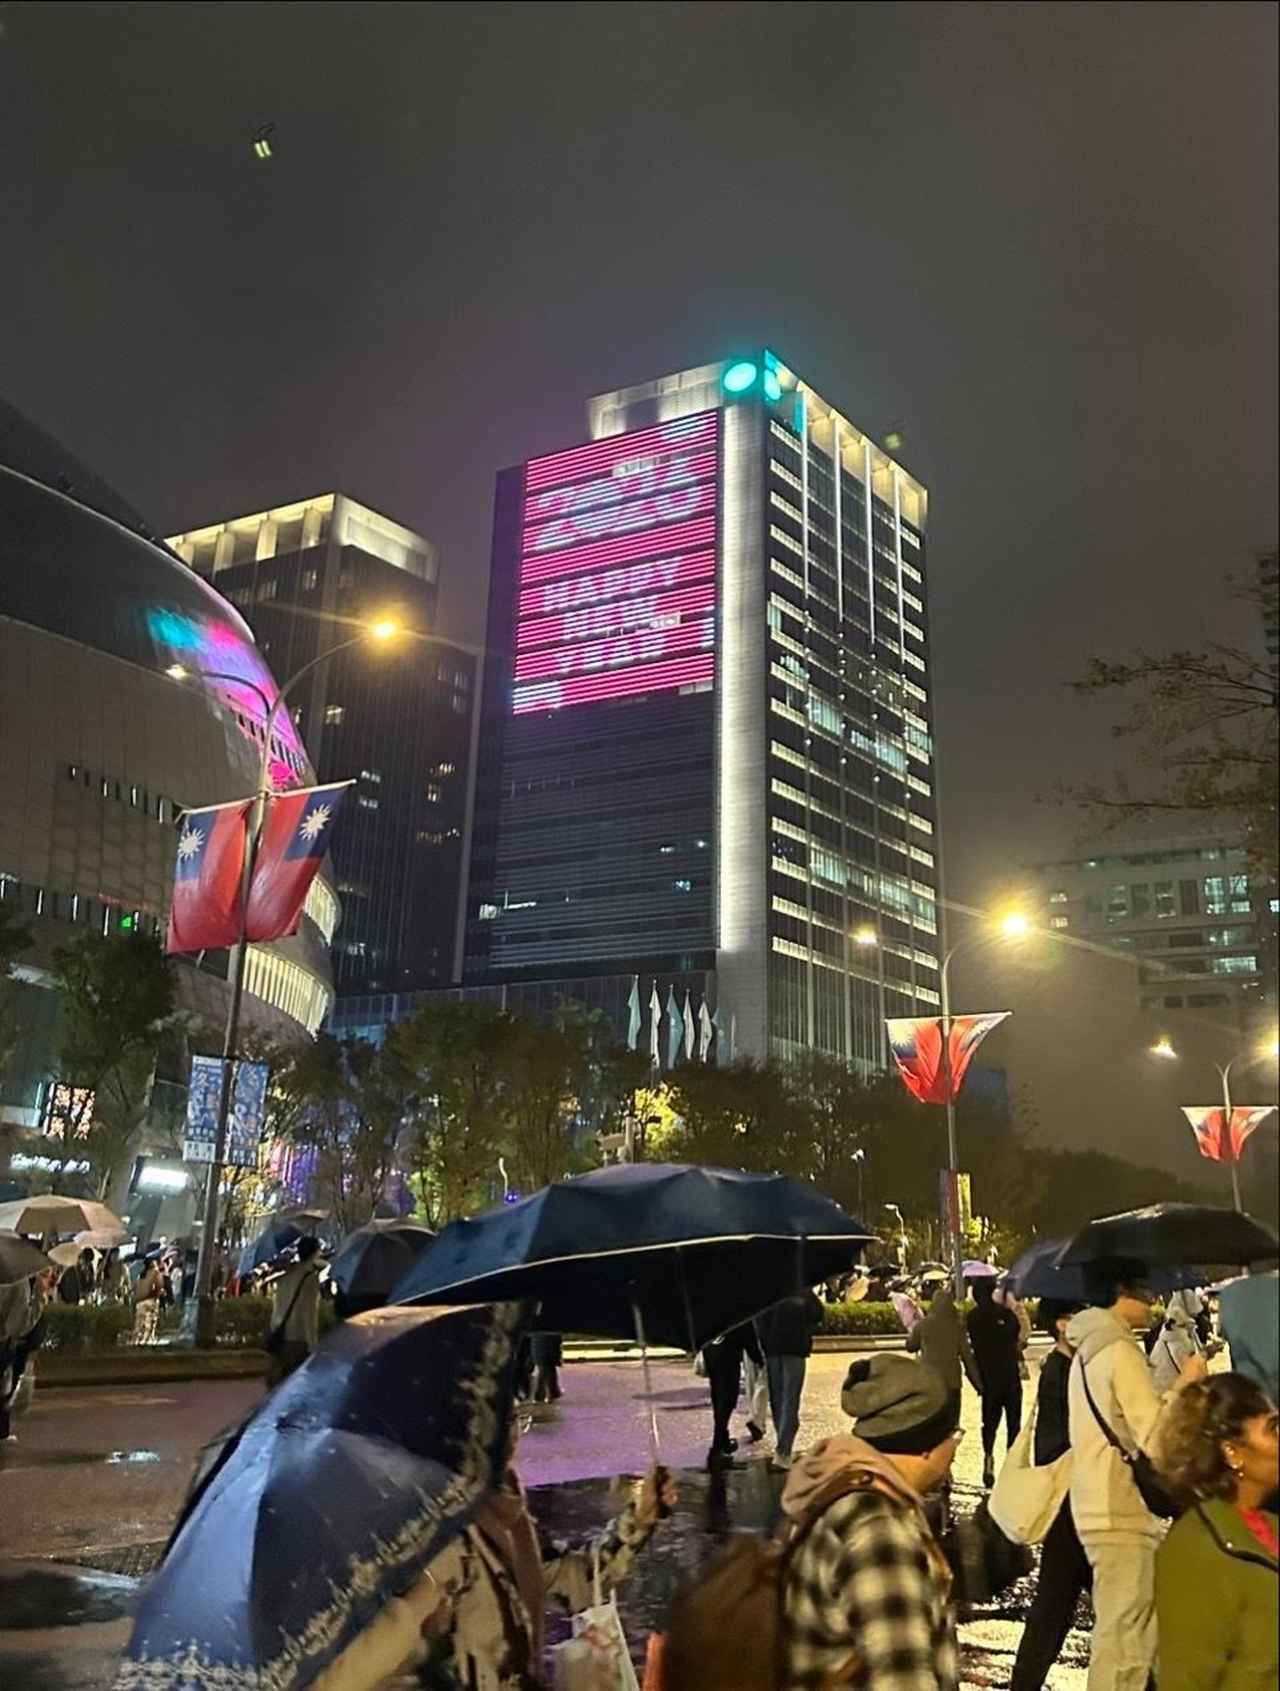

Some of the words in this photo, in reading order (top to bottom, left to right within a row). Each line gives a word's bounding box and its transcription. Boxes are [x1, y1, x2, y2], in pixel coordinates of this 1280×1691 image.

[536, 456, 702, 550] 2026
[543, 557, 682, 612] HAPPY
[562, 595, 658, 640] NEW
[554, 631, 665, 673] YEAR
